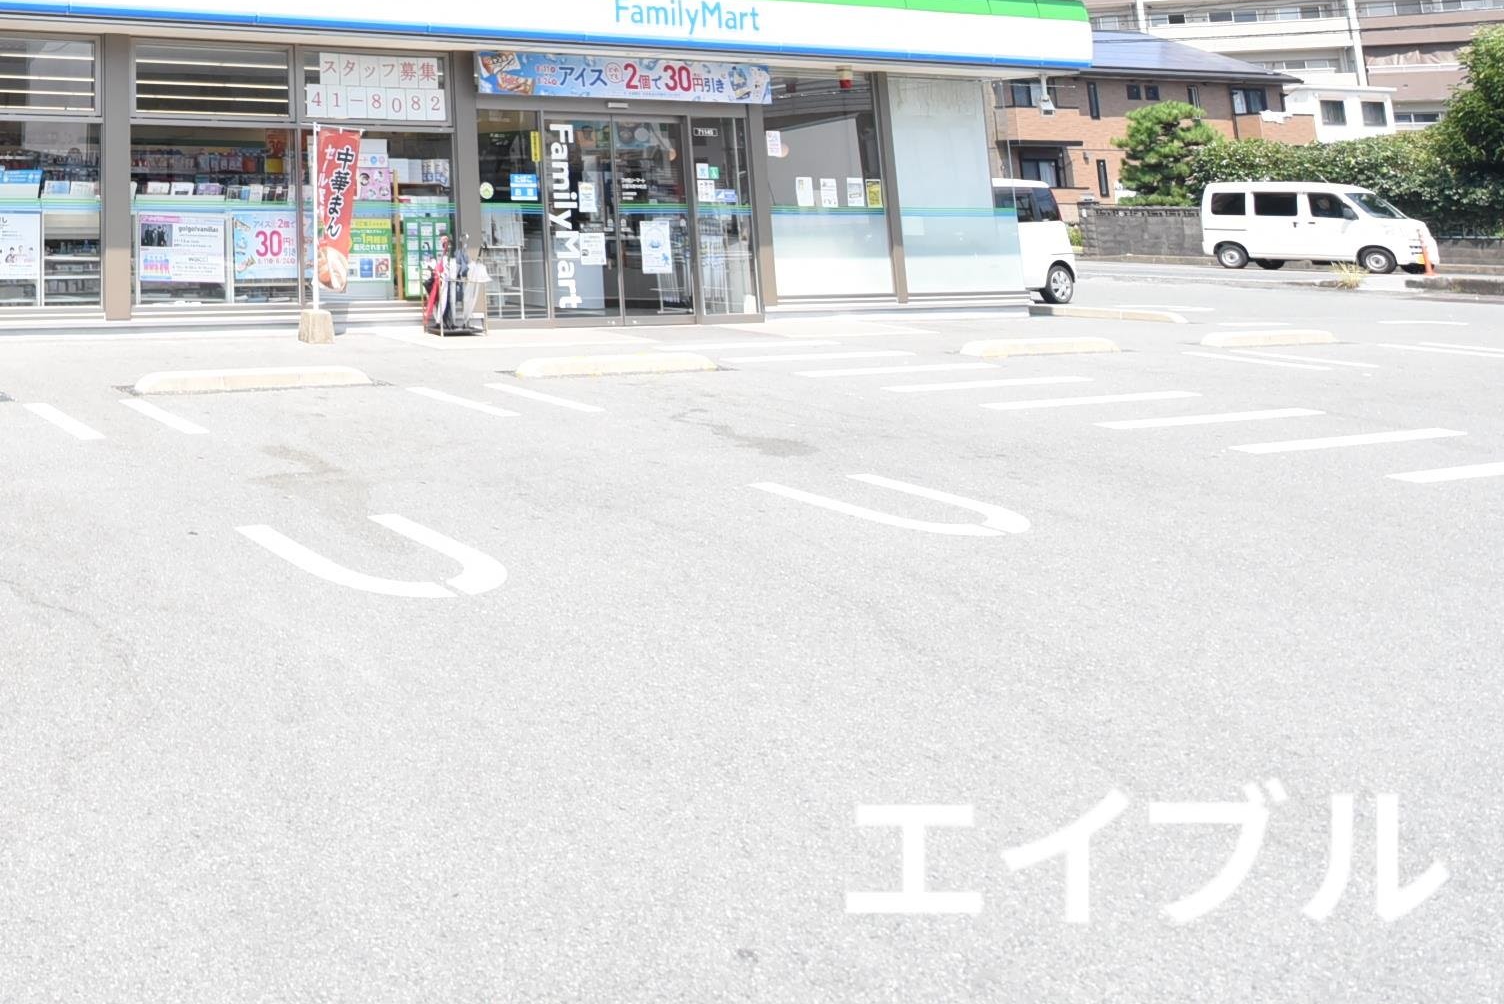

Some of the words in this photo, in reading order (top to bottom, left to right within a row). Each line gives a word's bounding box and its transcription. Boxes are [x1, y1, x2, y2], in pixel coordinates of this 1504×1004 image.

[322, 60, 438, 82] スタッフ募集
[558, 65, 608, 87] アイス
[325, 145, 356, 239] 中華まん
[548, 123, 583, 310] FamilyMart
[255, 229, 283, 257] 30
